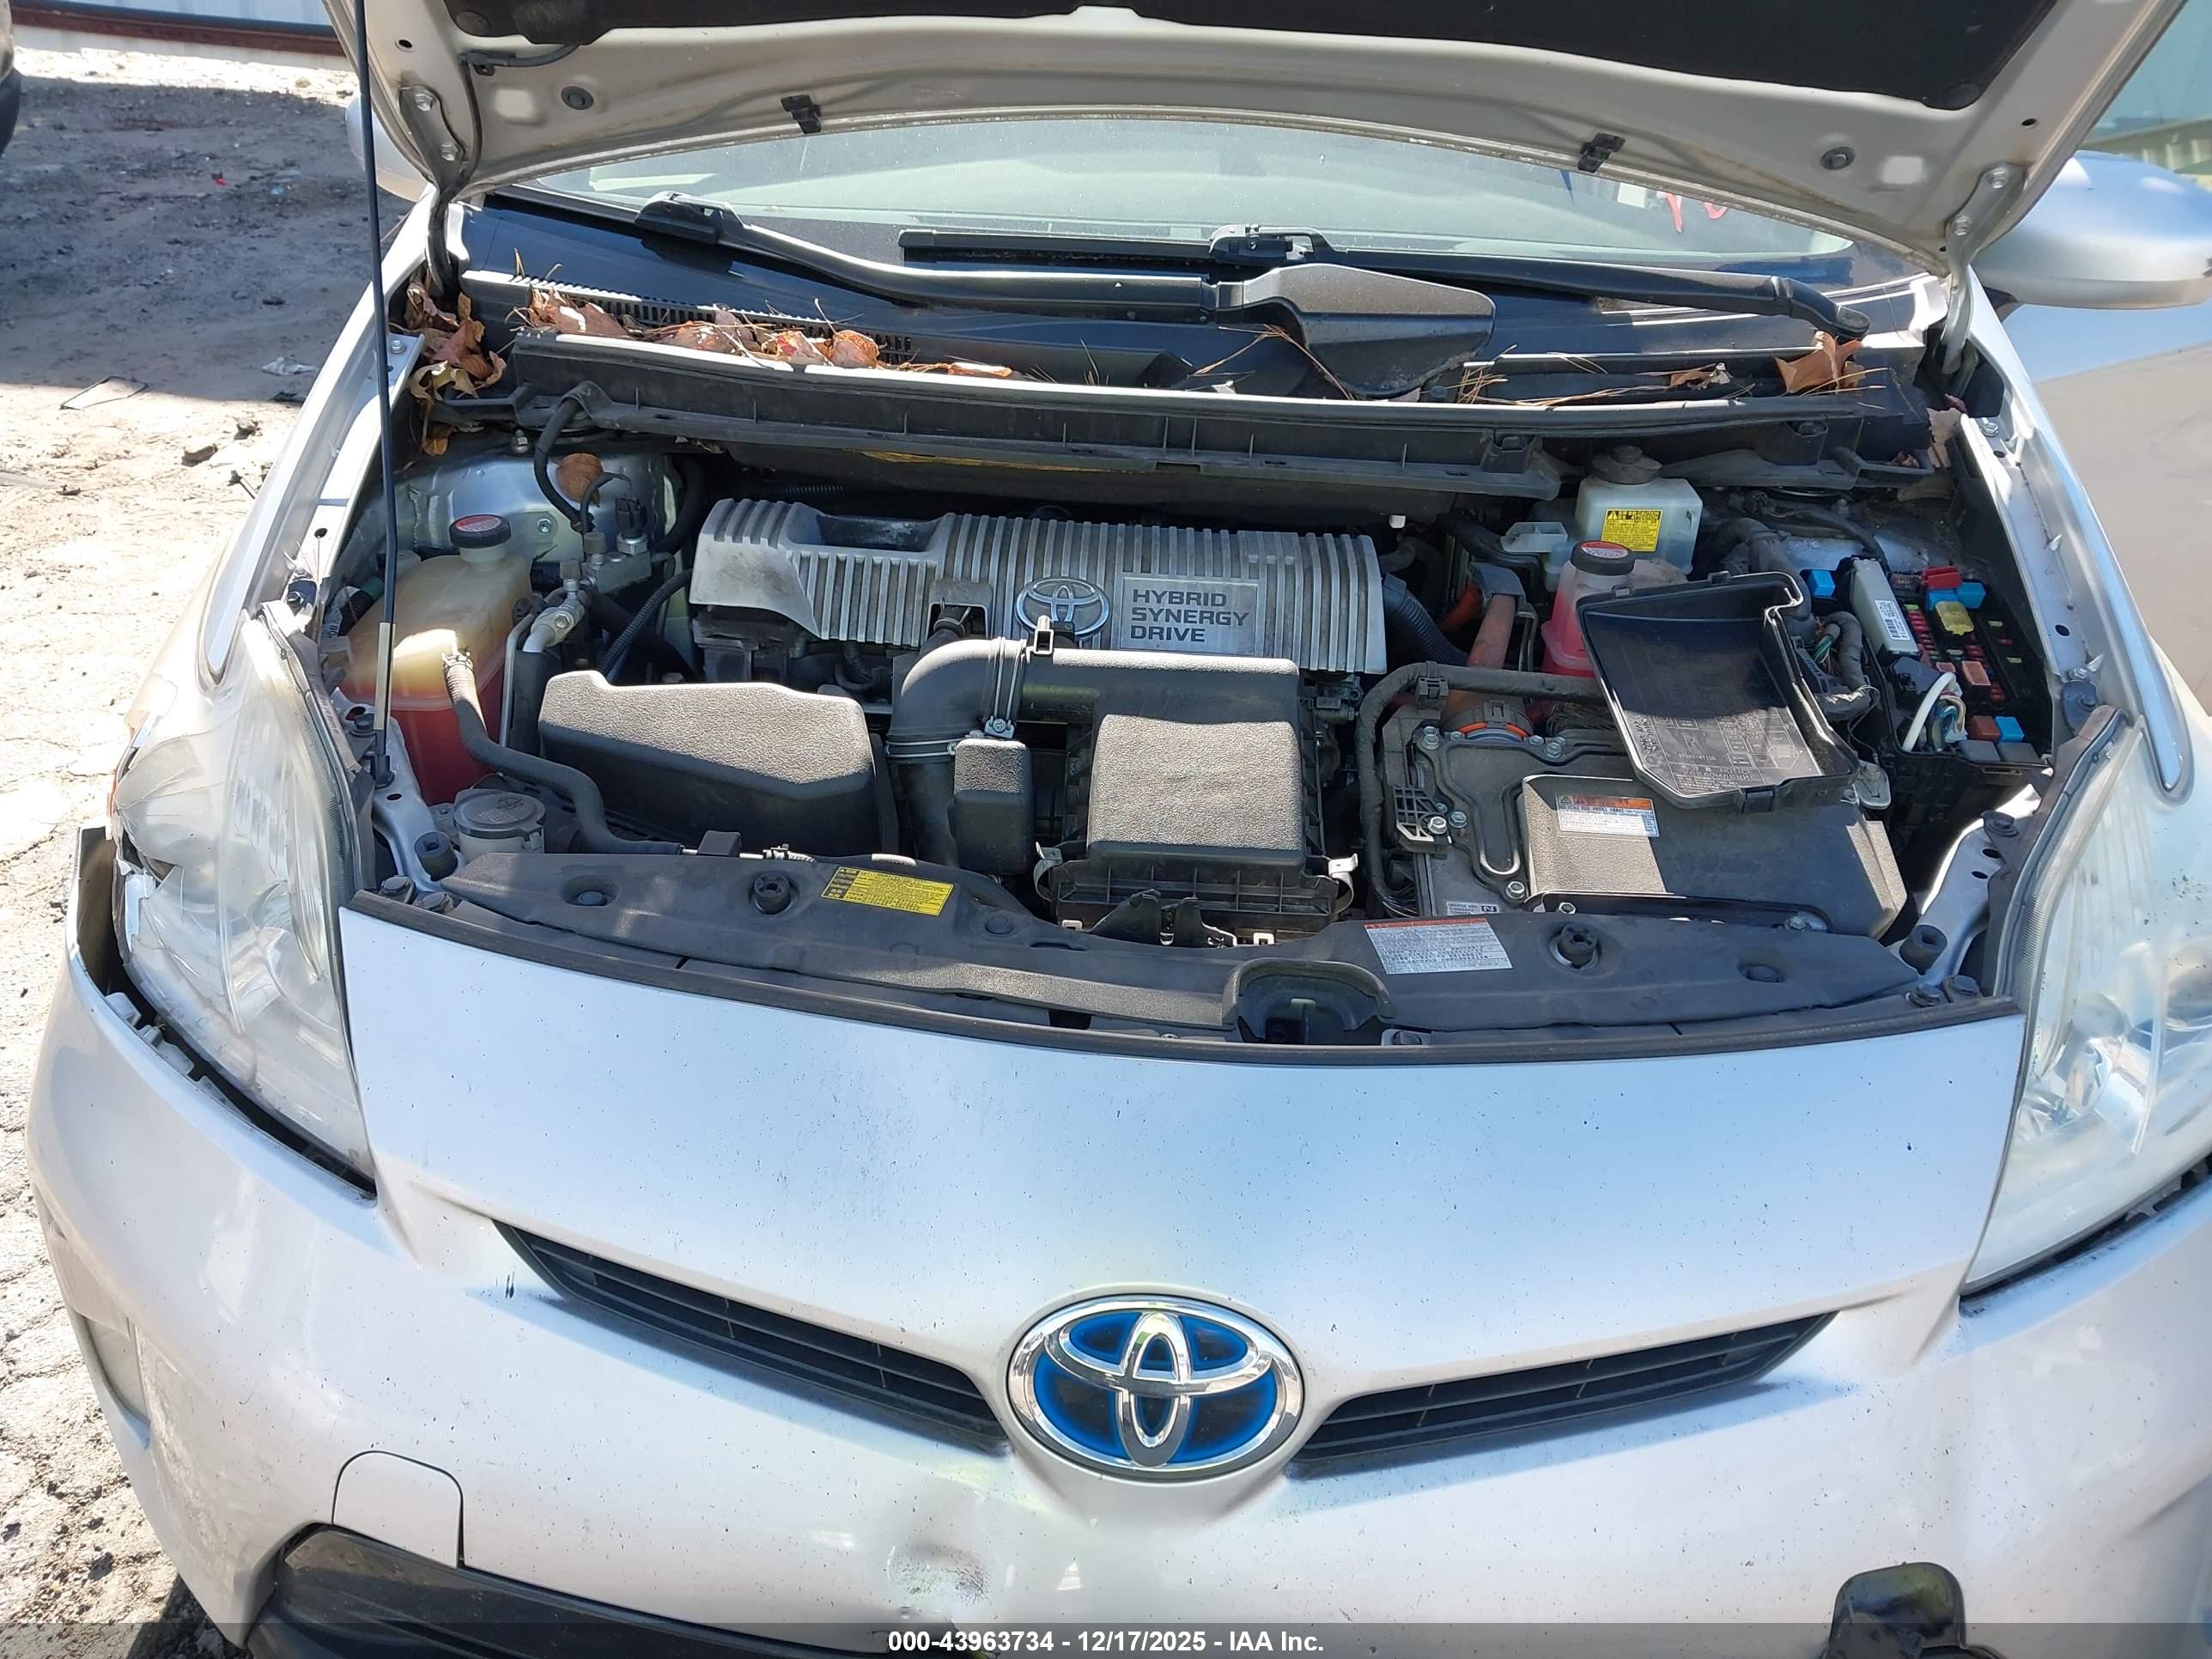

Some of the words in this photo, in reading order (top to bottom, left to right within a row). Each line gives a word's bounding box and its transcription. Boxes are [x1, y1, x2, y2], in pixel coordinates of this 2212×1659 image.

[1133, 589, 1226, 607] HYBRID
[1131, 607, 1249, 626] SYNERGY
[1130, 625, 1206, 642] DRIVE
